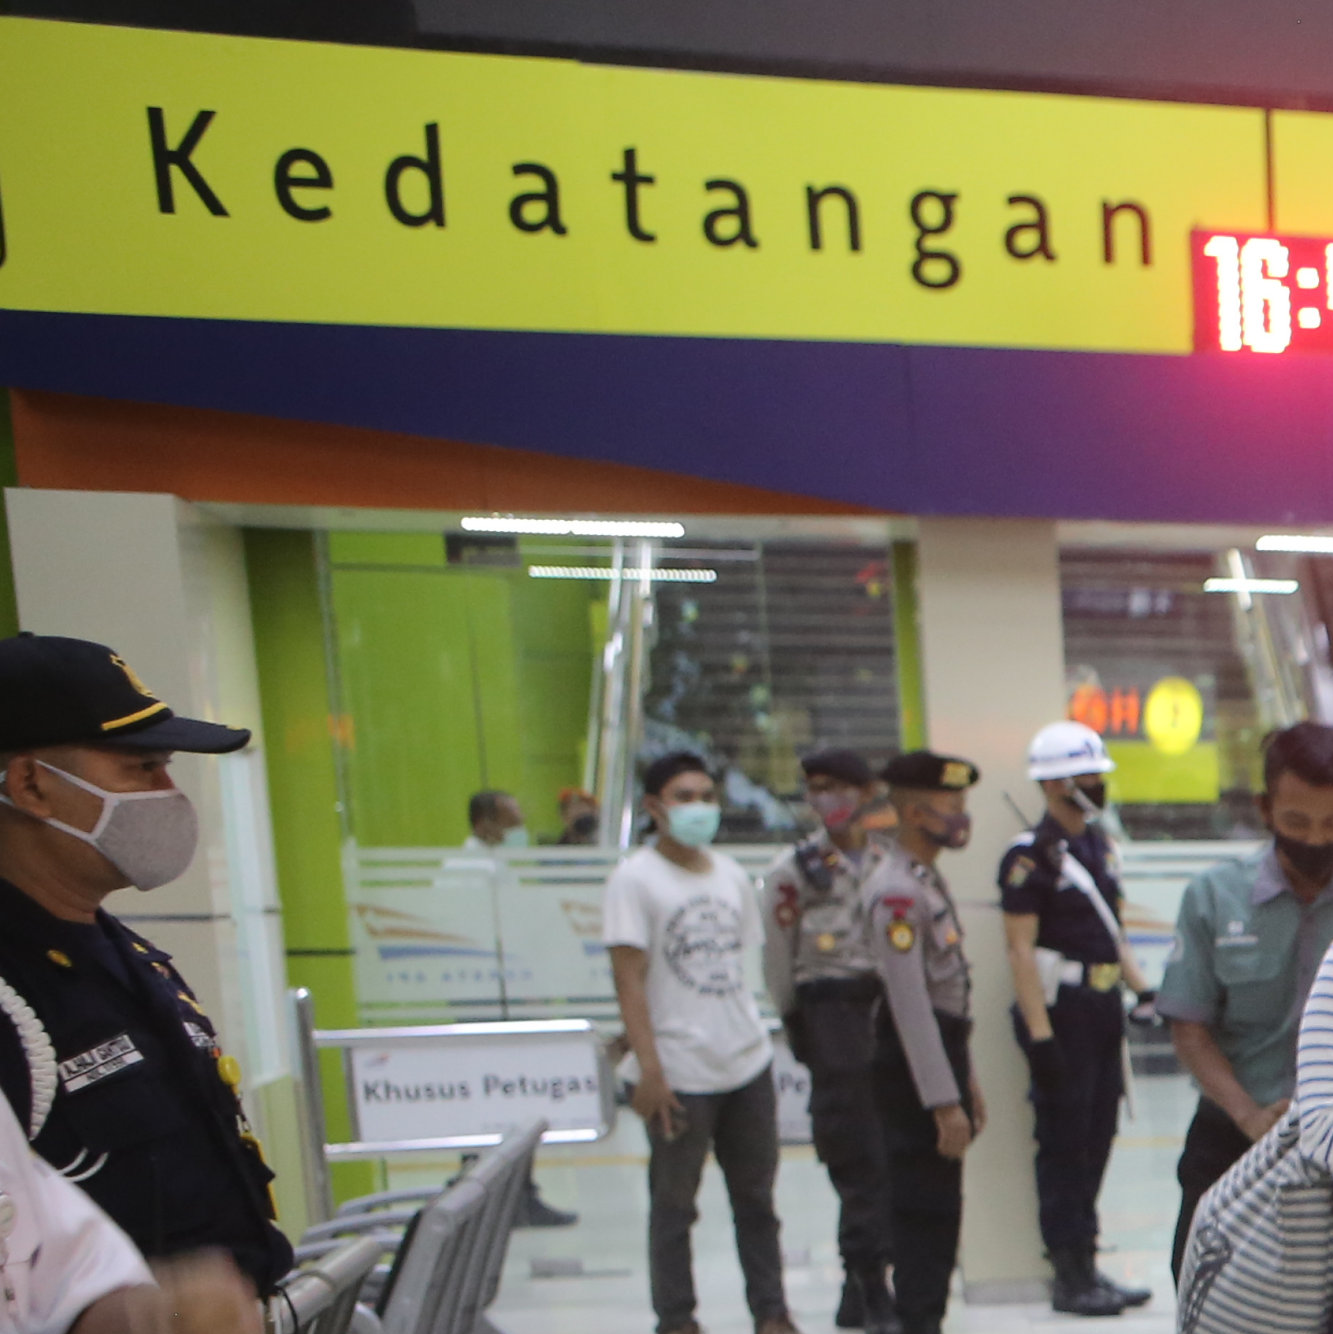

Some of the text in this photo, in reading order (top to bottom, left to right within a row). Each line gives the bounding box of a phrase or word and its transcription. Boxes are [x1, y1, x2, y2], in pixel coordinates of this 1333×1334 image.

[147, 106, 1154, 290] Kedatangan
[363, 1073, 598, 1102] Khusus Petugas
